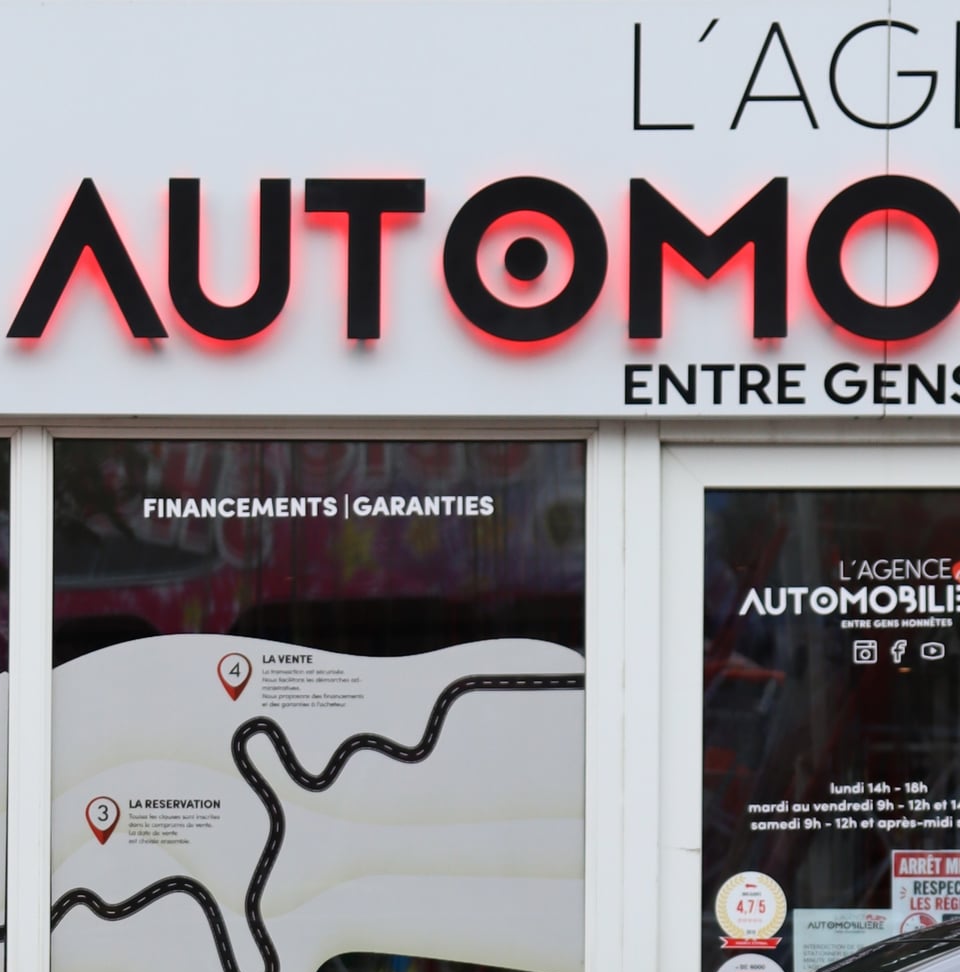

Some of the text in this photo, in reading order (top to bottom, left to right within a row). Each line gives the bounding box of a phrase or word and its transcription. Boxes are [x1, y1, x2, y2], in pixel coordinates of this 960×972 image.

[634, 18, 960, 131] L'AG
[624, 362, 960, 405] ENTRE GEN
[143, 497, 338, 518] FINANCEMENTS
[353, 496, 495, 516] GARANTIES
[840, 558, 952, 581] L'AGENCE
[739, 585, 960, 616] AUTOMOBILI
[841, 615, 953, 629] ENTRE GENS HONNÊTES
[262, 654, 313, 664] LA VENTE
[228, 661, 241, 678] 4
[830, 781, 929, 795] lundi 14h 18h
[129, 799, 221, 809] LA RESERVATION
[748, 800, 789, 813] mardi
[792, 803, 810, 813] au
[813, 799, 874, 813] vendredi
[877, 799, 895, 812] 9h
[908, 799, 931, 811] 12h
[933, 799, 948, 811] et
[97, 804, 110, 822] 3
[750, 817, 801, 831] samedi
[804, 817, 822, 830] 9h
[835, 817, 858, 830] 12h
[860, 817, 874, 829] et
[877, 815, 953, 832] après-midi
[899, 854, 943, 876] ARRÊT
[910, 896, 932, 911] LES
